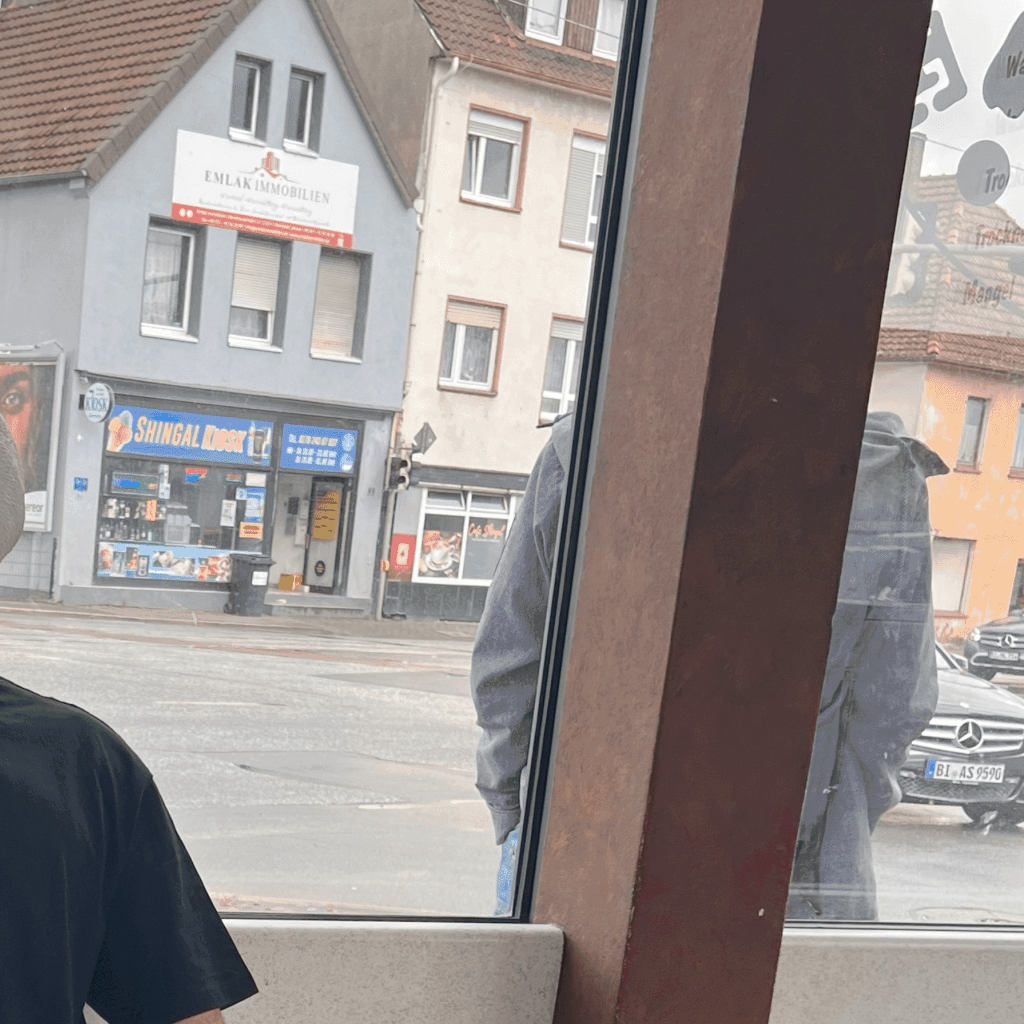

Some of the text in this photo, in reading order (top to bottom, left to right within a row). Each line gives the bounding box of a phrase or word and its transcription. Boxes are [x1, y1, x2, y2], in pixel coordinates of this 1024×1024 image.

[204, 170, 252, 190] EMLAK
[255, 179, 330, 204] IMMOBILIEN
[134, 415, 200, 448] SHINGAL
